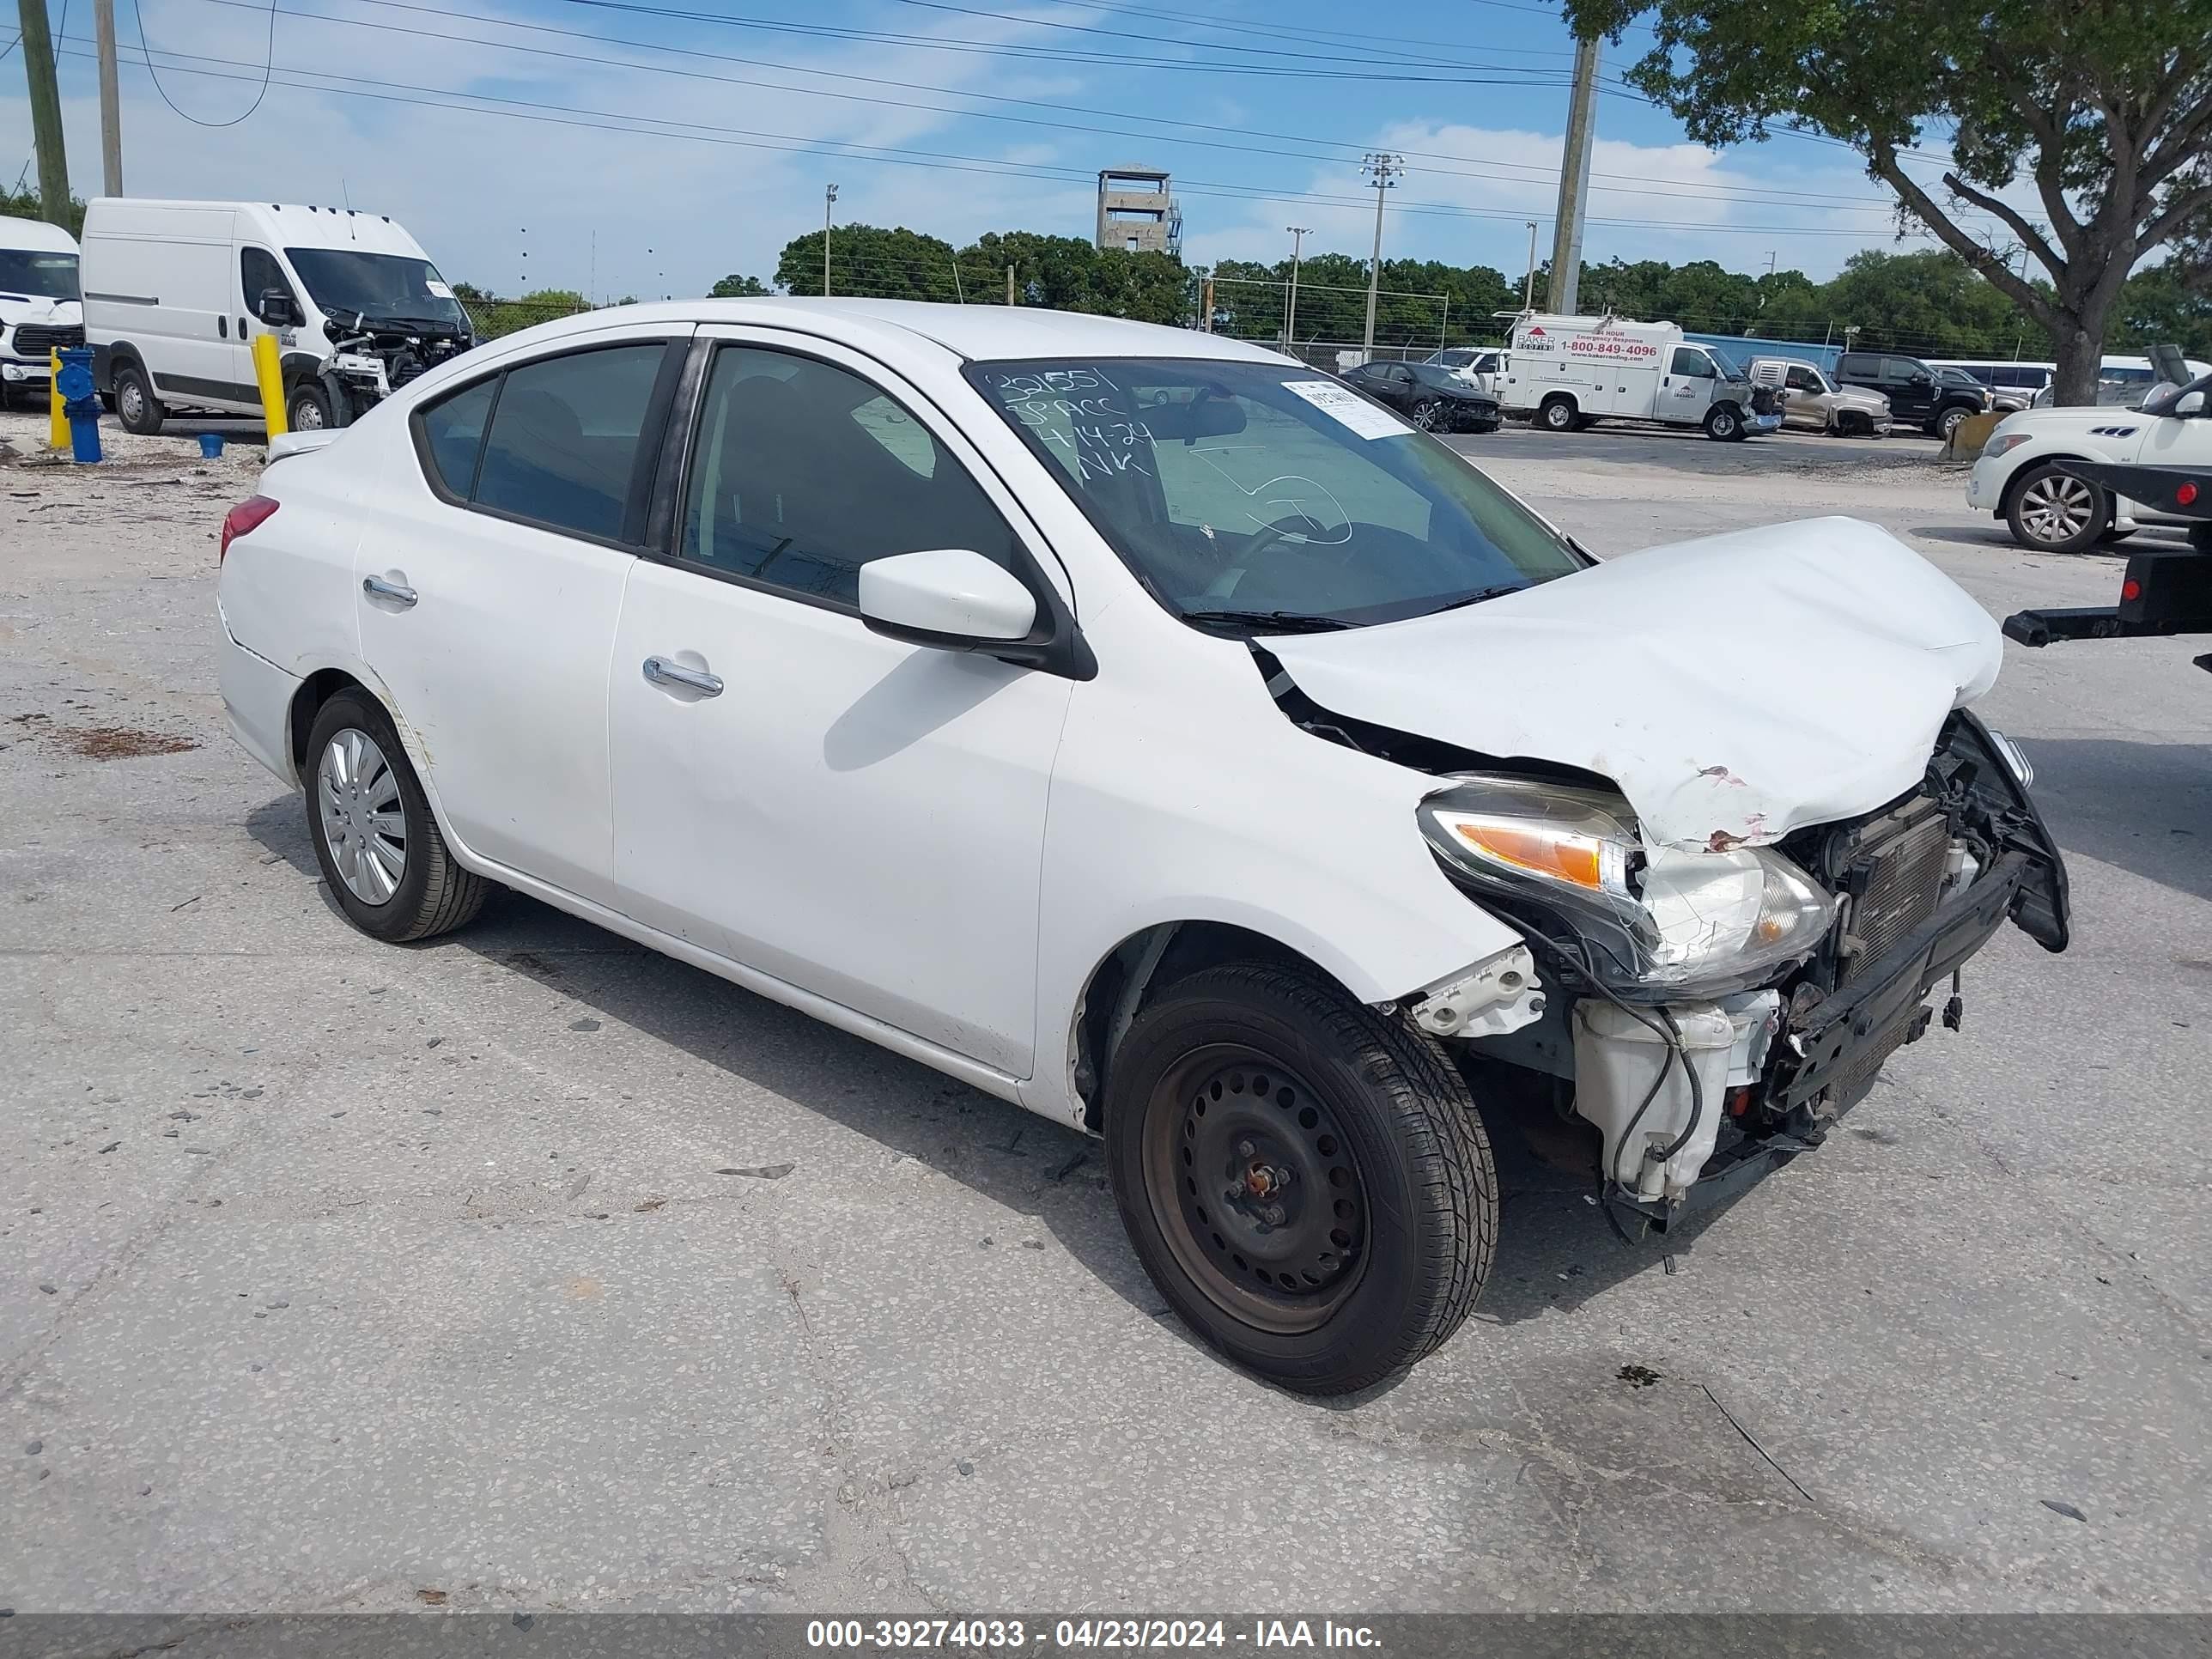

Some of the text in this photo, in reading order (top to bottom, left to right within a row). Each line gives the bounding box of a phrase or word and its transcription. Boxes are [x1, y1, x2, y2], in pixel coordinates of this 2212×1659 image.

[1517, 334, 1556, 345] BAKER
[1577, 334, 1611, 343] Emergency
[1560, 340, 1657, 356] 1-800-849-4096
[1571, 352, 1644, 362] www.bakerroofing.com
